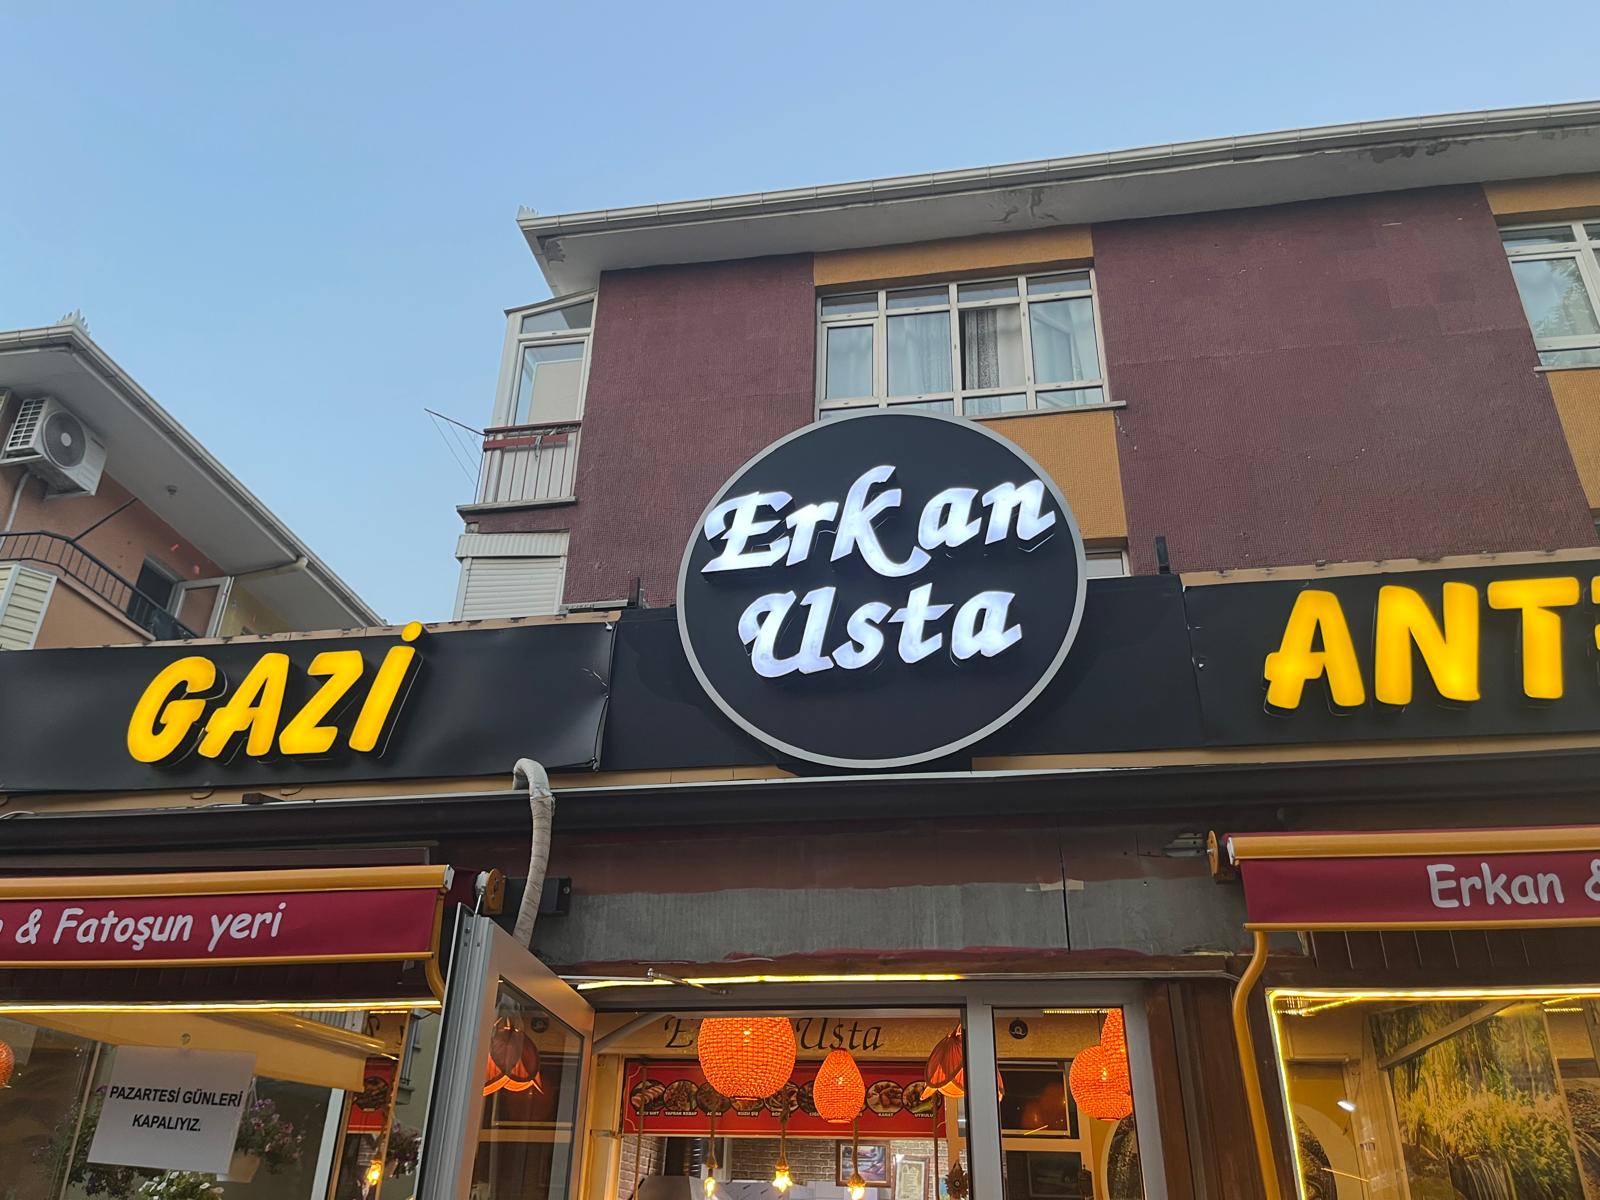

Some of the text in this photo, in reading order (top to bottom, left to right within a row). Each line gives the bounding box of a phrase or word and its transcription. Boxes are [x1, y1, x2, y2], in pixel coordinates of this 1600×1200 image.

[699, 464, 1056, 578] Erkan
[737, 582, 1023, 678] Usta
[126, 620, 424, 764] GAZİ
[1427, 862, 1565, 909] Erkan
[15, 902, 287, 952] & Fatoşun yeri
[796, 1017, 884, 1052] Usta
[109, 1085, 244, 1107] PAZARTESİ GÜNLERİ
[131, 1113, 202, 1132] KAPALIYIZ.
